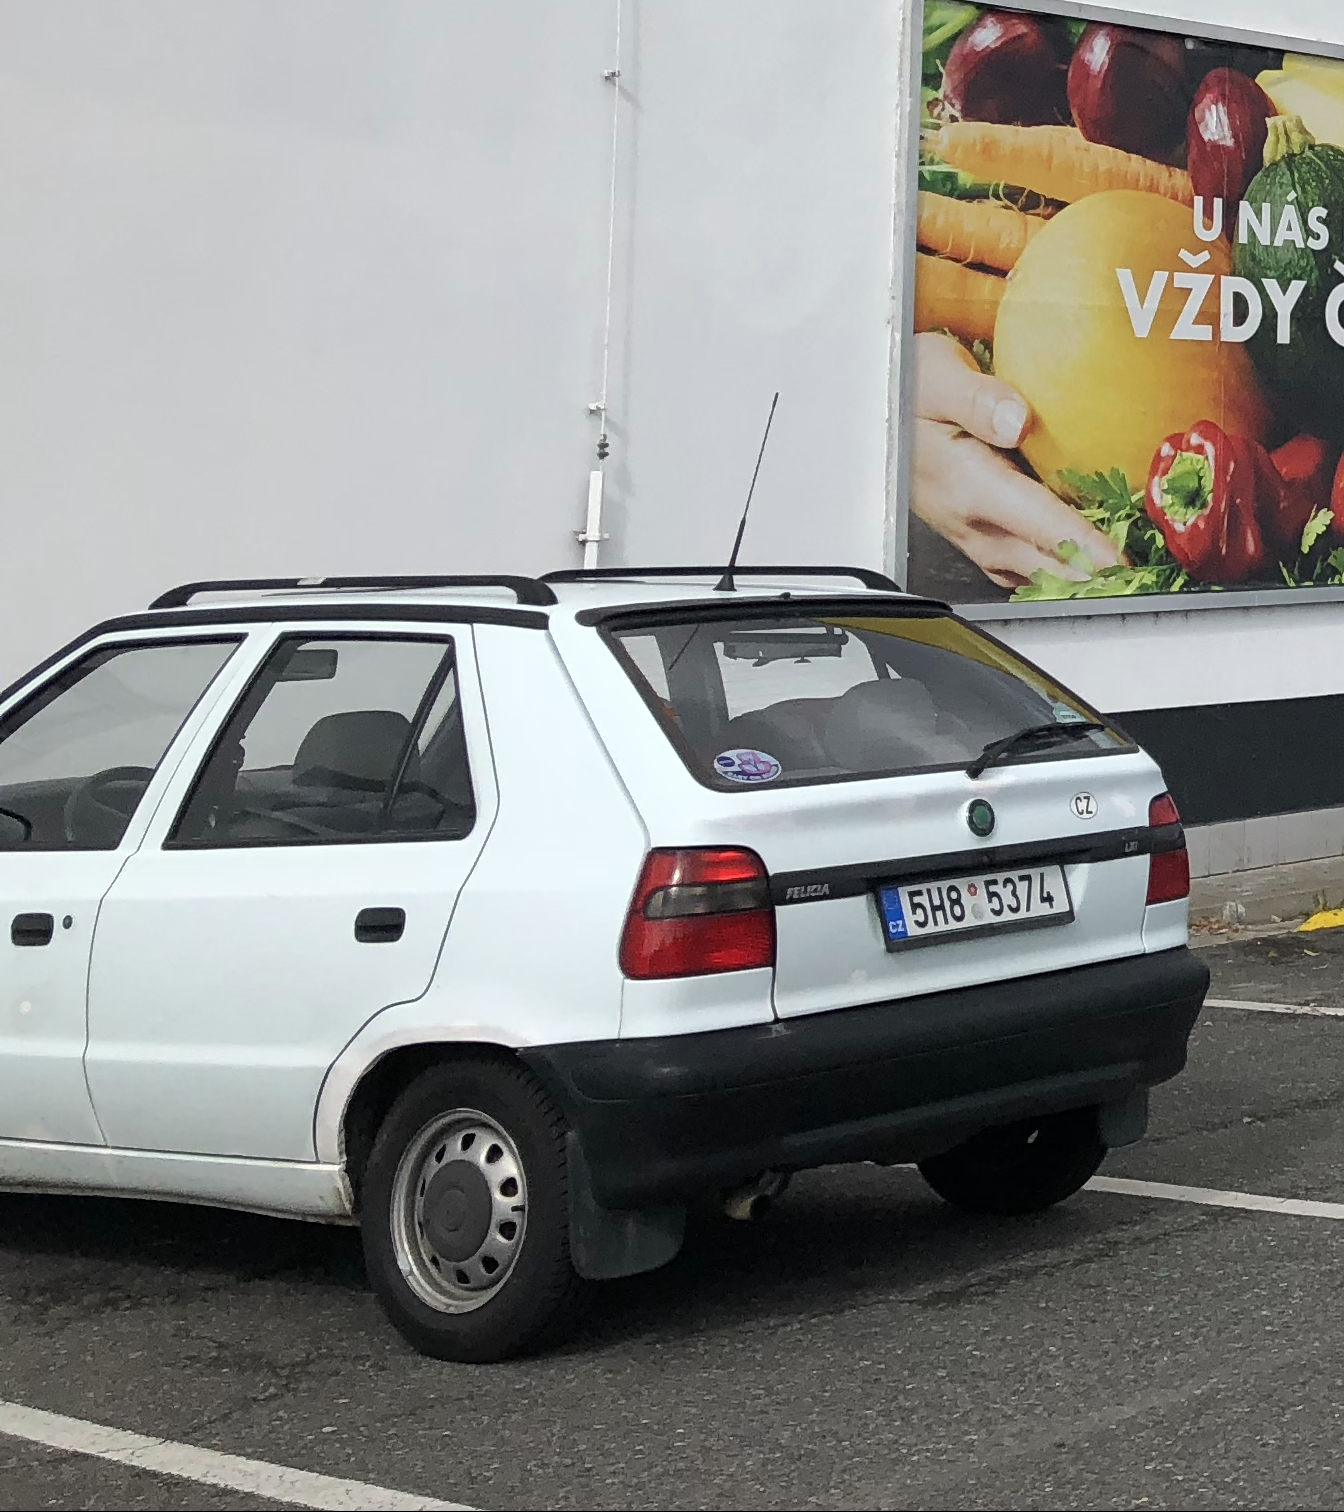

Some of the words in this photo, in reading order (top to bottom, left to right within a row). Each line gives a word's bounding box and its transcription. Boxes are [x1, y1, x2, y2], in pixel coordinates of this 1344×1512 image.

[1191, 195, 1224, 242] U
[1238, 191, 1329, 251] NÁS
[1115, 249, 1304, 345] VŽDY
[1075, 796, 1093, 816] CZ
[786, 883, 830, 900] FELICIA
[908, 885, 966, 928] 5H8
[983, 872, 1055, 917] 5374
[889, 920, 905, 934] CZ
